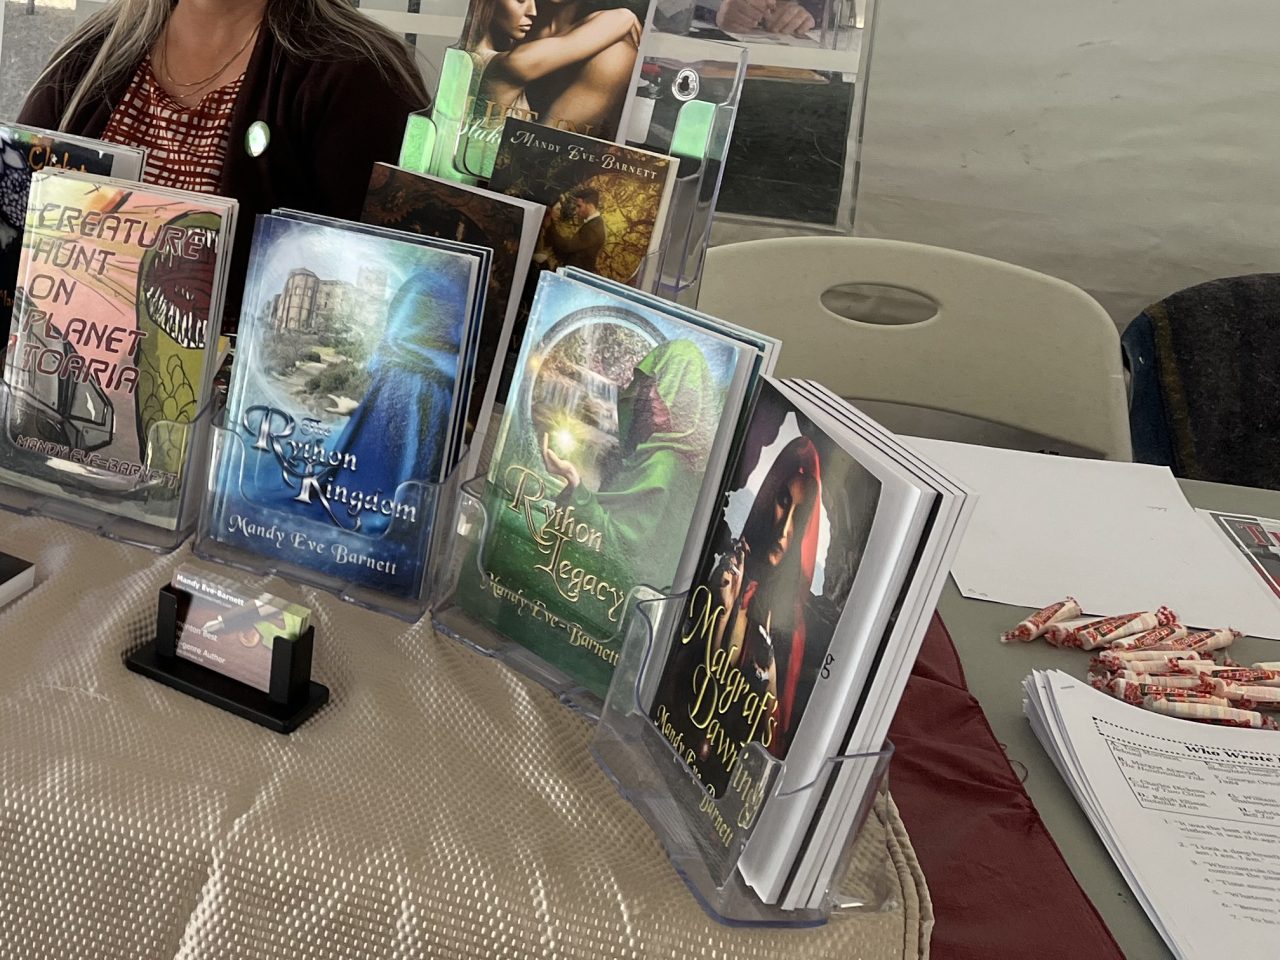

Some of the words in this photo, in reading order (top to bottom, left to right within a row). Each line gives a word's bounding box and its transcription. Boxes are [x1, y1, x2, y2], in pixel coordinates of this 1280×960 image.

[37, 203, 206, 259] CREATURE
[32, 239, 115, 276] HUNT
[28, 273, 77, 307] ON
[23, 310, 148, 356] PLANET
[22, 344, 140, 394] TOARIA
[16, 434, 69, 458] MANDY
[243, 405, 359, 478] Rython
[293, 461, 417, 532] Kingdom
[504, 464, 603, 552] Rython
[228, 514, 285, 548] Mandy
[291, 533, 325, 554] Eve
[331, 544, 397, 575] Barnett
[177, 574, 200, 589] Mandy
[533, 528, 625, 622] Legacy
[1185, 745, 1221, 757] Who
[1225, 751, 1274, 763] Wrote
